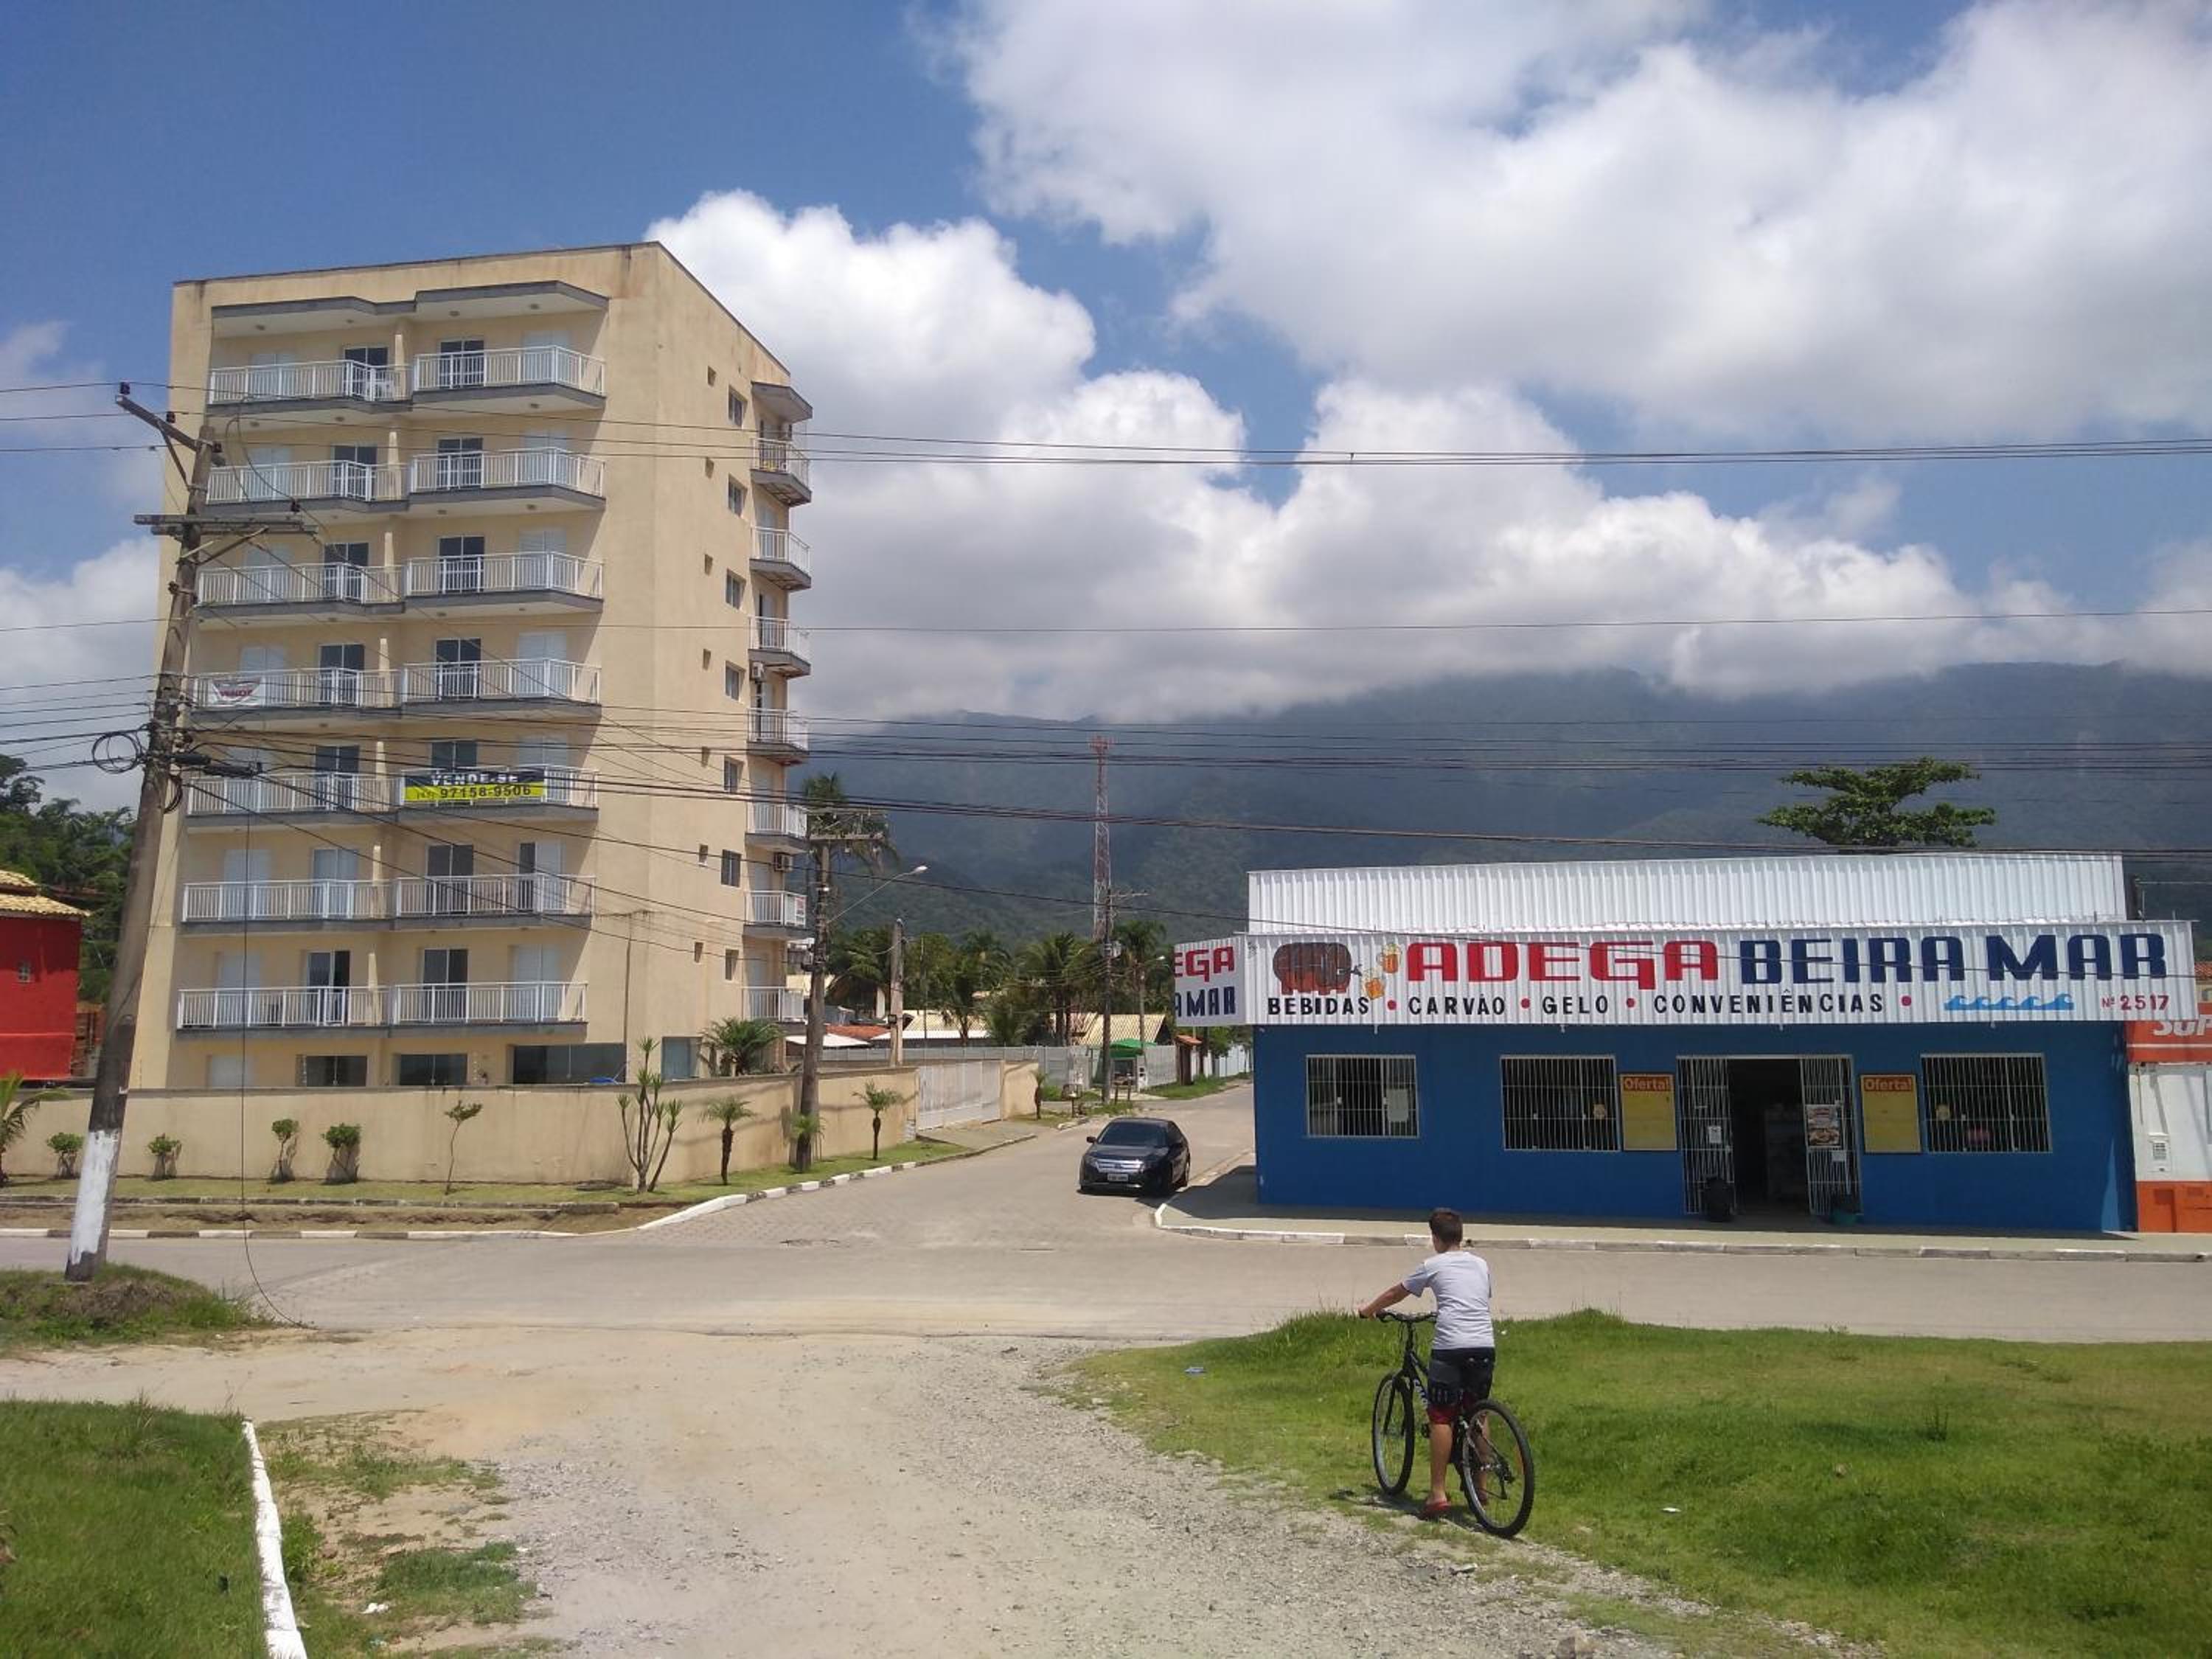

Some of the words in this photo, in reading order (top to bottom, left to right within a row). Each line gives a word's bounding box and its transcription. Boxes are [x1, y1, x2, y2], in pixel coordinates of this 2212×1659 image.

[1407, 941, 1719, 990] ADEGA
[1739, 936, 1966, 984] BEIRA
[1986, 933, 2167, 981] MAR
[1267, 996, 1369, 1015] BEBIDAS
[1542, 995, 1608, 1015] GELO
[1654, 989, 1883, 1014] CONVENIÊNCIAS
[2120, 995, 2169, 1010] 2517
[1624, 1077, 1669, 1090] Oferta!
[1865, 1079, 1912, 1091] Oferta!
